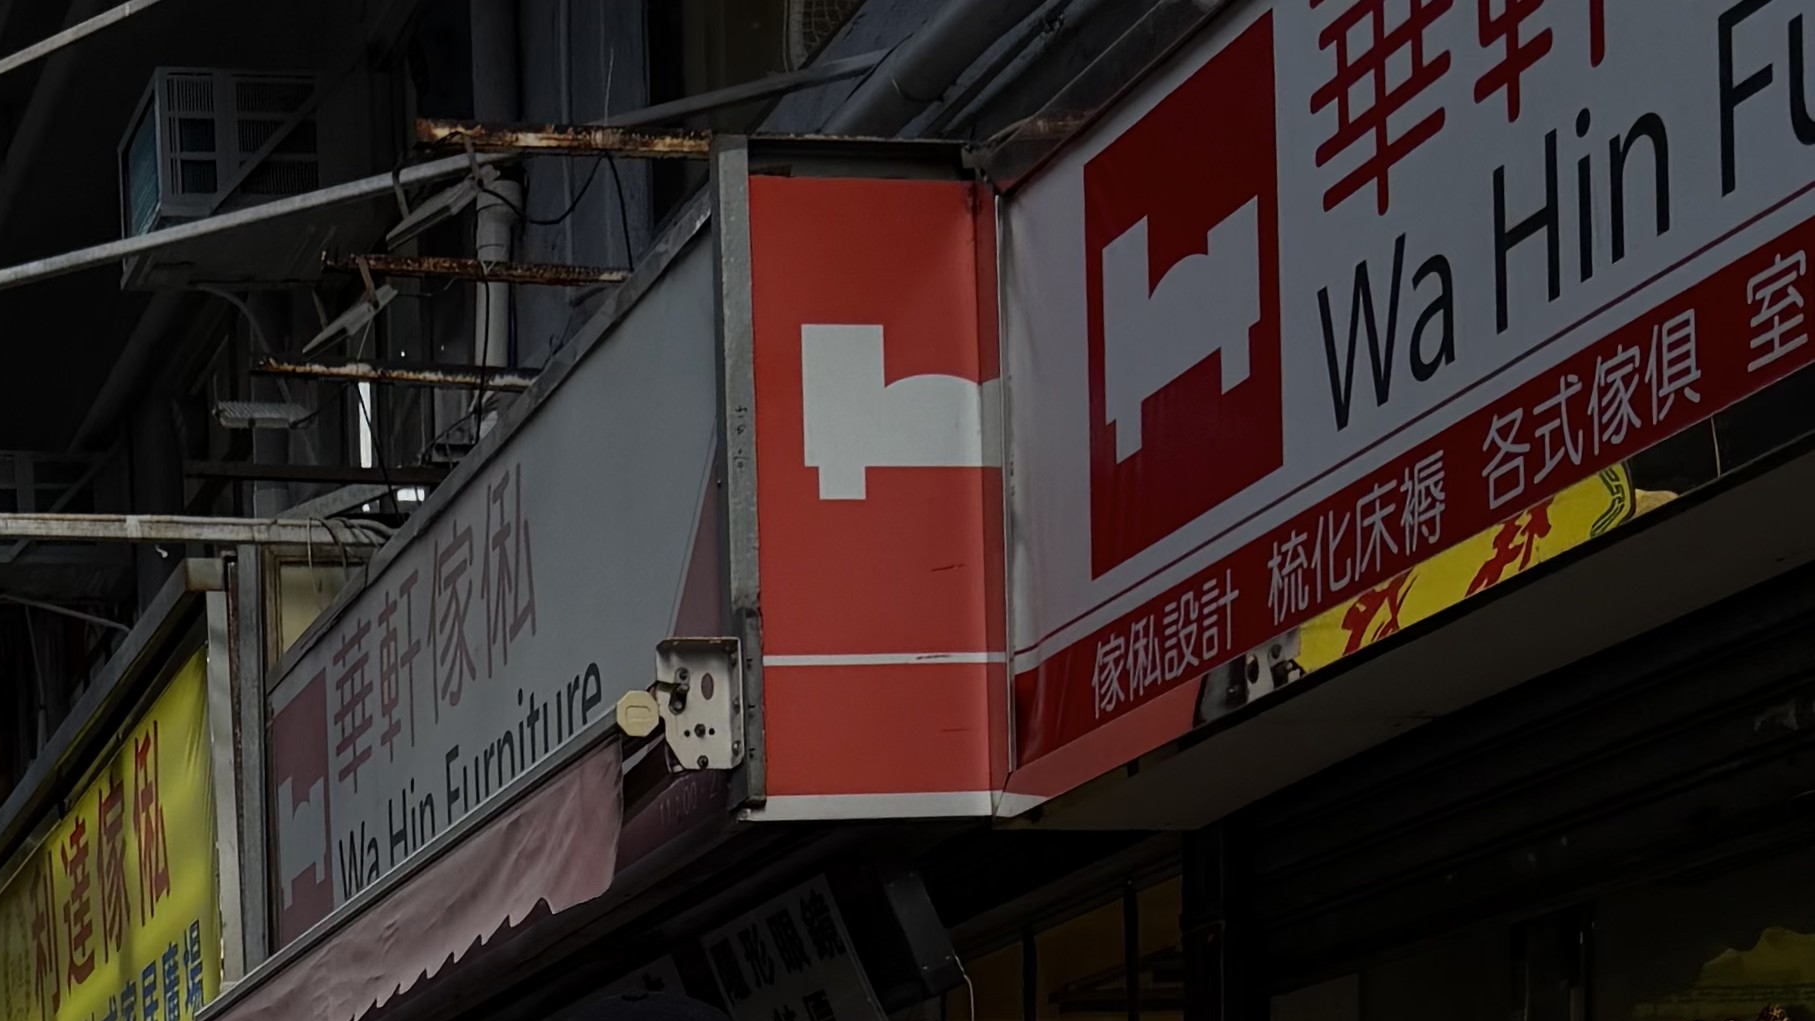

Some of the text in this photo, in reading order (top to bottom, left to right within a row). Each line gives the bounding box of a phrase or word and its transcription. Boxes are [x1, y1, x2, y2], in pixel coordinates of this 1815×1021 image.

[1317, 232, 1456, 432] Wa
[1492, 107, 1671, 335] Hin
[332, 462, 538, 795] 華軒傢俬
[1091, 571, 1241, 720] 傢俬設計
[1267, 449, 1448, 627] 梳化床褥
[1482, 310, 1703, 512] 各式傢俱
[1746, 250, 1808, 375] 室
[338, 662, 603, 900] Wa Hin Furniture
